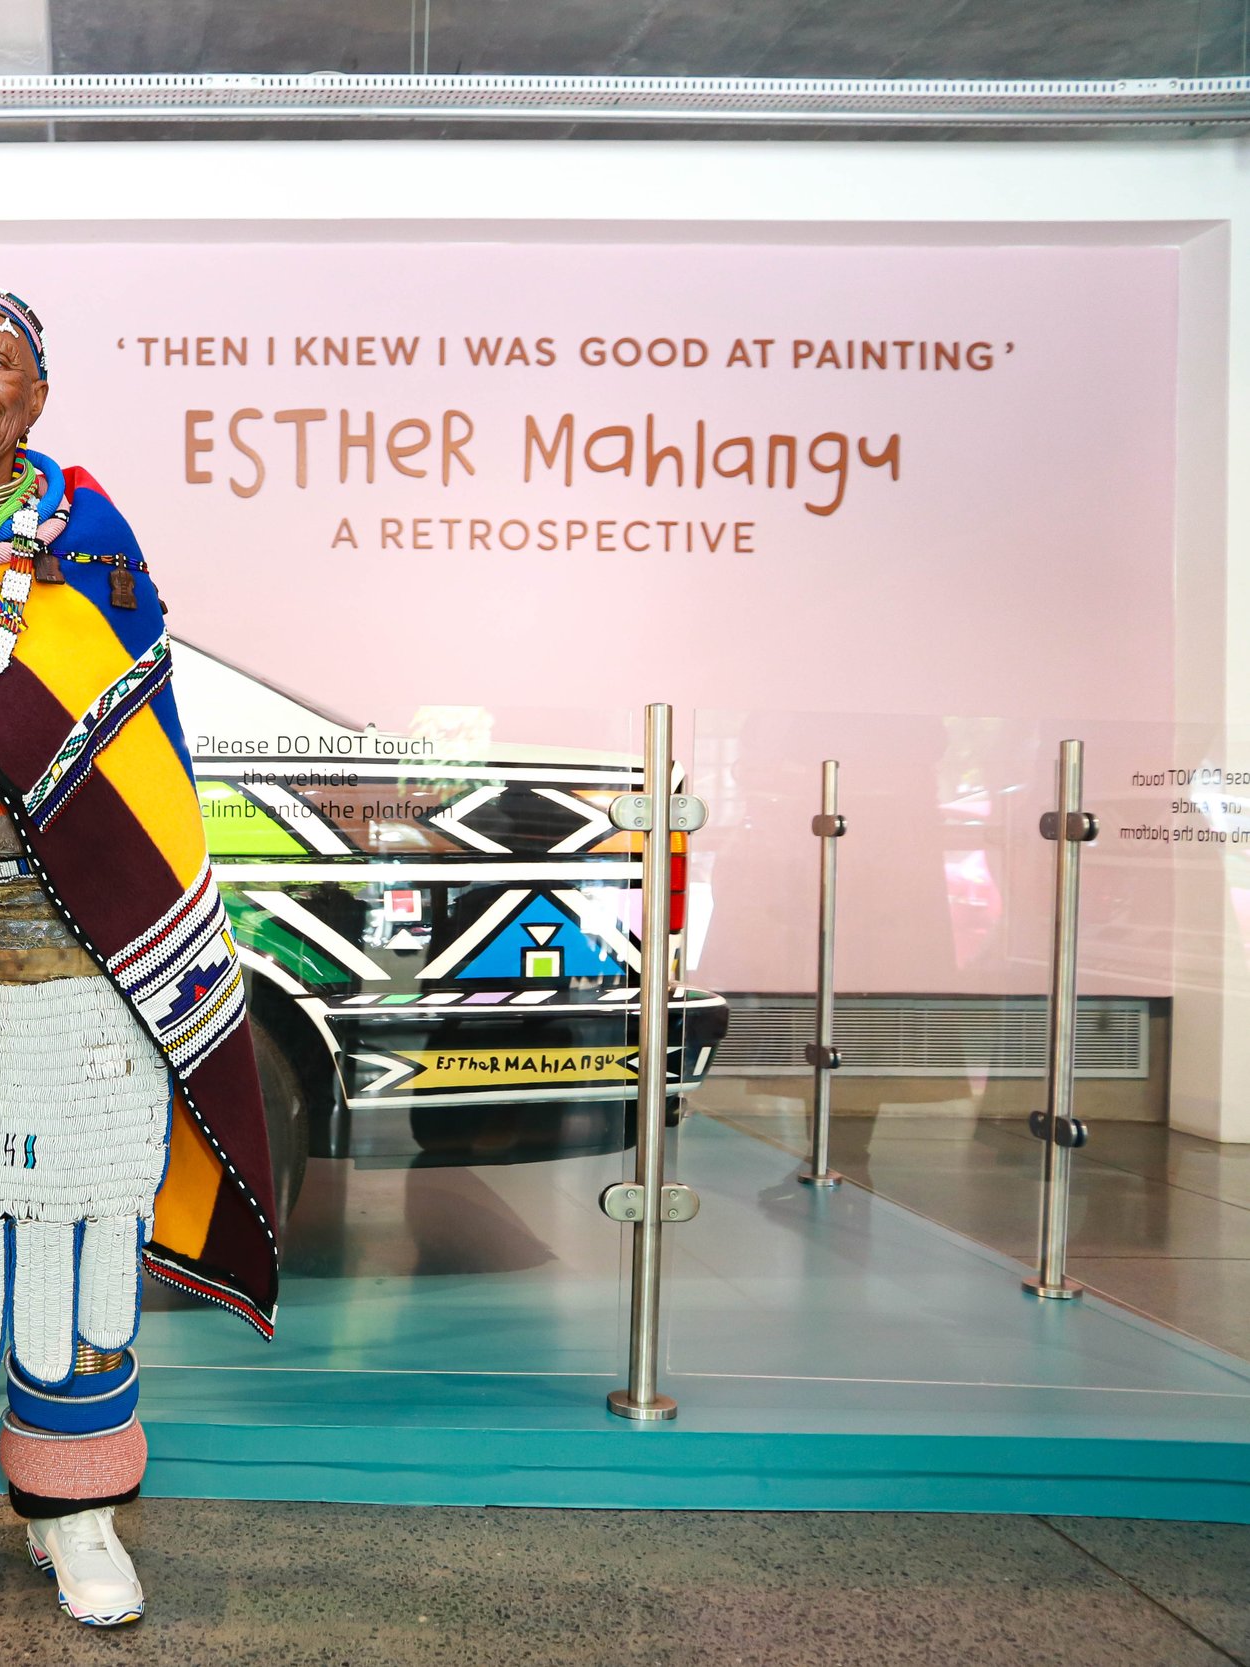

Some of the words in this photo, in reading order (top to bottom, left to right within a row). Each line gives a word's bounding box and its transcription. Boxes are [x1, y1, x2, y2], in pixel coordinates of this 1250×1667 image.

[268, 336, 276, 365] I
[295, 335, 420, 366] KNEW
[439, 336, 447, 367] I
[466, 336, 556, 367] WAS
[580, 337, 710, 367] GOOD
[727, 339, 774, 368] AT
[523, 412, 901, 517] Mahlangu
[333, 517, 359, 549] A
[381, 517, 756, 553] RETROSPECTIVE
[196, 735, 269, 754] Please
[277, 735, 310, 754] DO
[319, 735, 368, 754] NOT
[375, 736, 434, 755] touch
[243, 768, 277, 786] the
[284, 768, 359, 787] vehicle
[201, 800, 256, 818] climb
[265, 802, 313, 818] onto
[321, 801, 354, 819] the
[362, 801, 453, 822] platform
